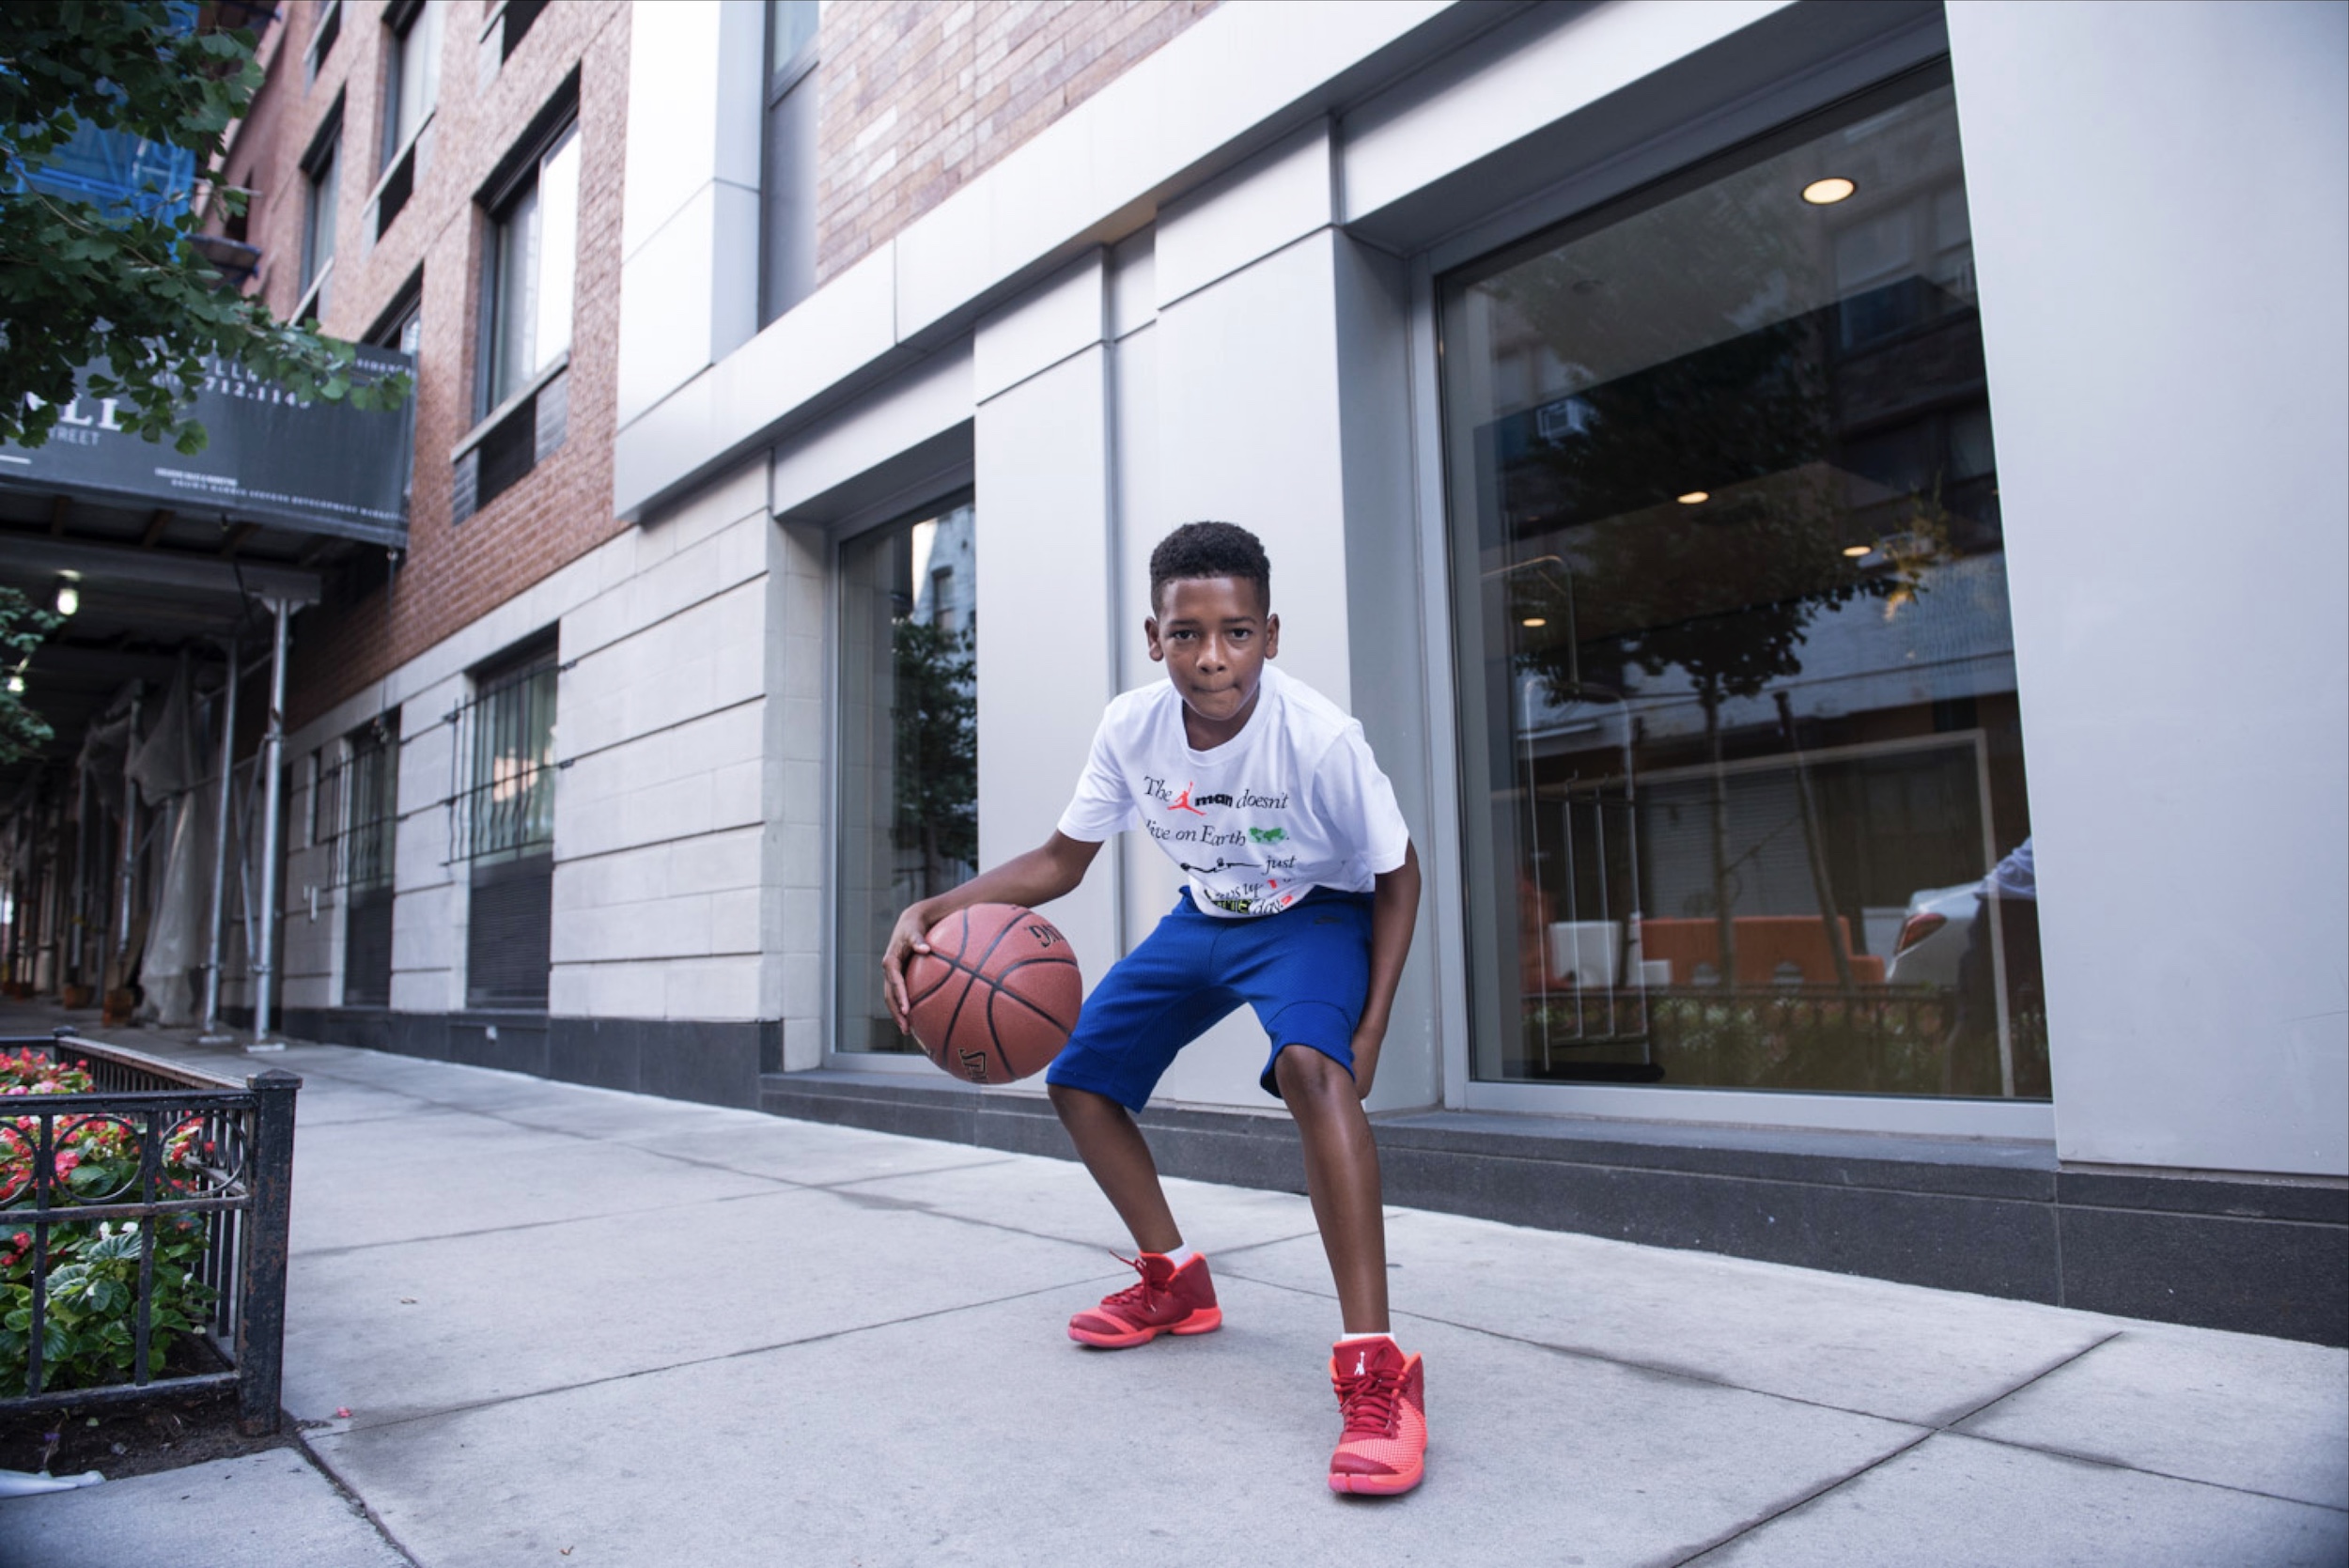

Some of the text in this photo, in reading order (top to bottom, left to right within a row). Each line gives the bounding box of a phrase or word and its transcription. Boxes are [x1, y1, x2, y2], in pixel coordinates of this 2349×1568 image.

[47, 426, 100, 446] TREET
[1143, 776, 1288, 809] The man doesn't
[1175, 829, 1196, 841] on
[1200, 825, 1246, 846] Earth
[1261, 855, 1297, 876] just
